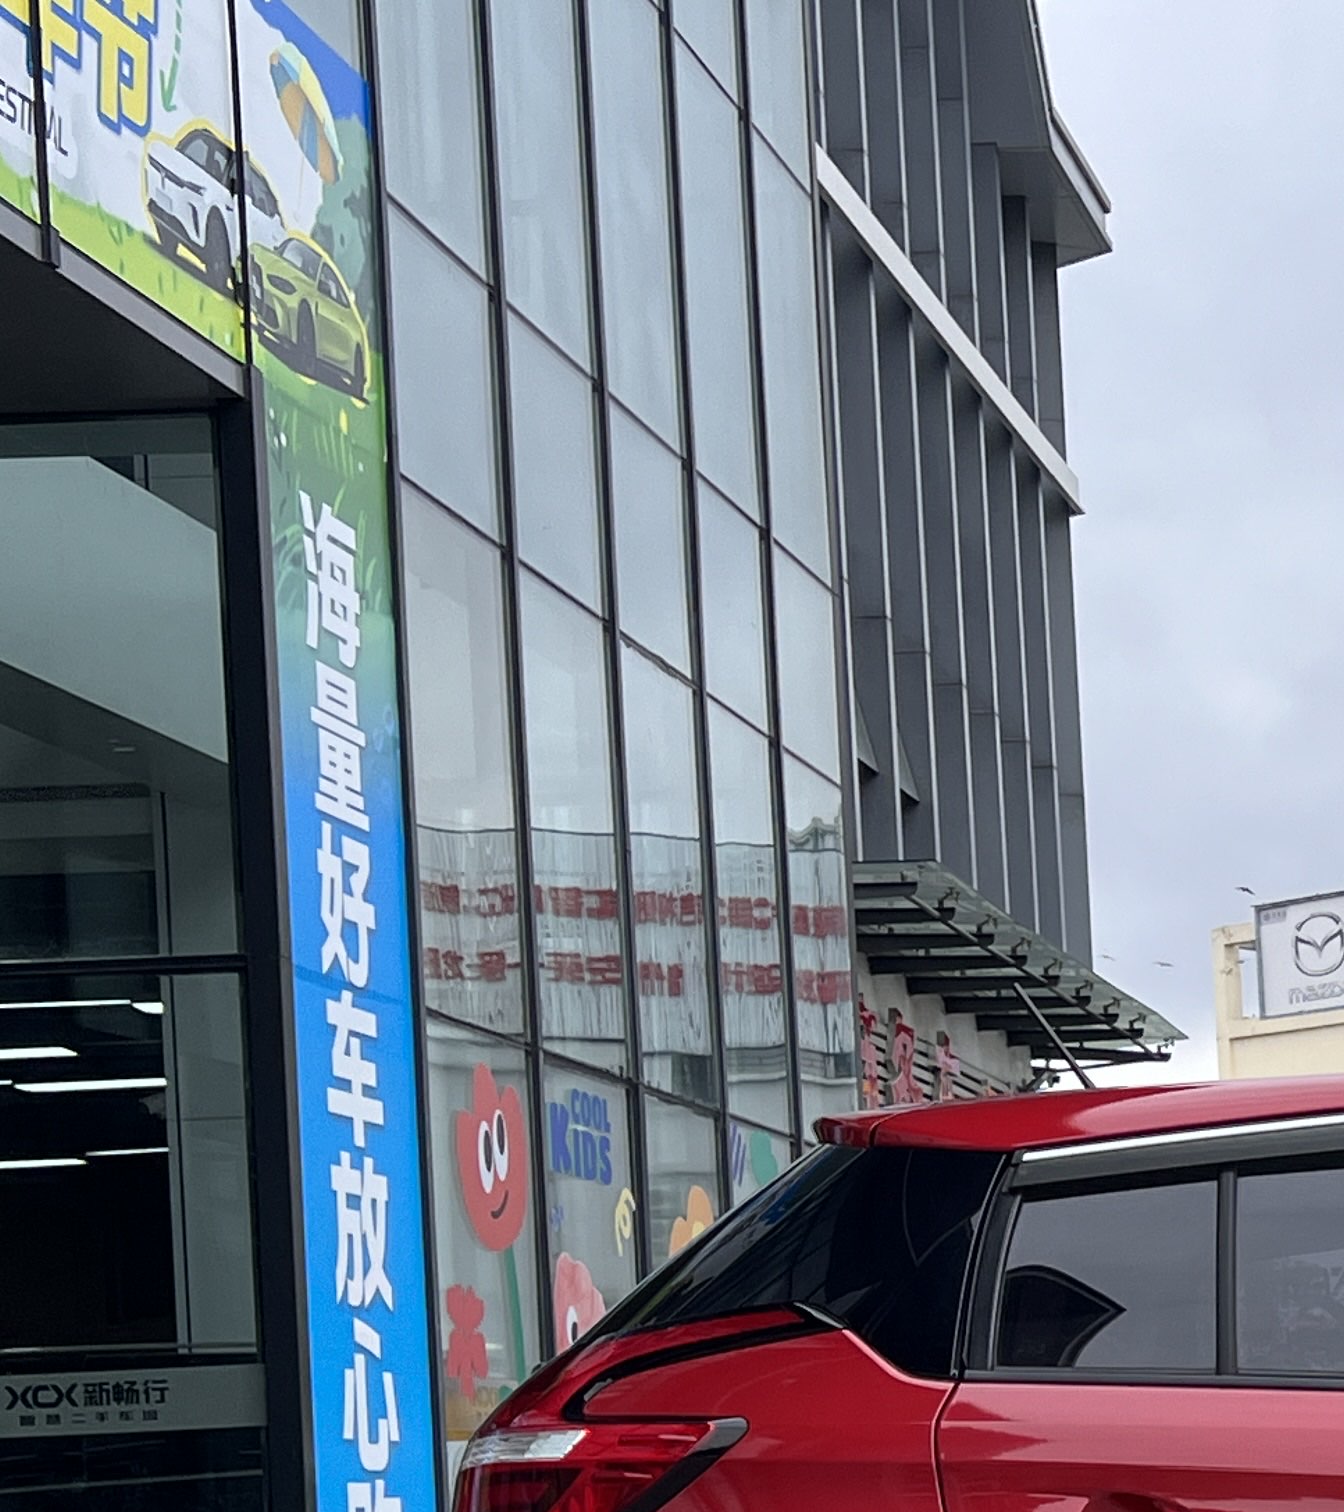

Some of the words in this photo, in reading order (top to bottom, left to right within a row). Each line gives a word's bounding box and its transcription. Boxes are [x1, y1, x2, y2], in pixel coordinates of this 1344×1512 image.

[571, 1088, 611, 1133] COOL
[550, 1102, 612, 1186] KIDS
[83, 1379, 169, 1407] 新畅行
